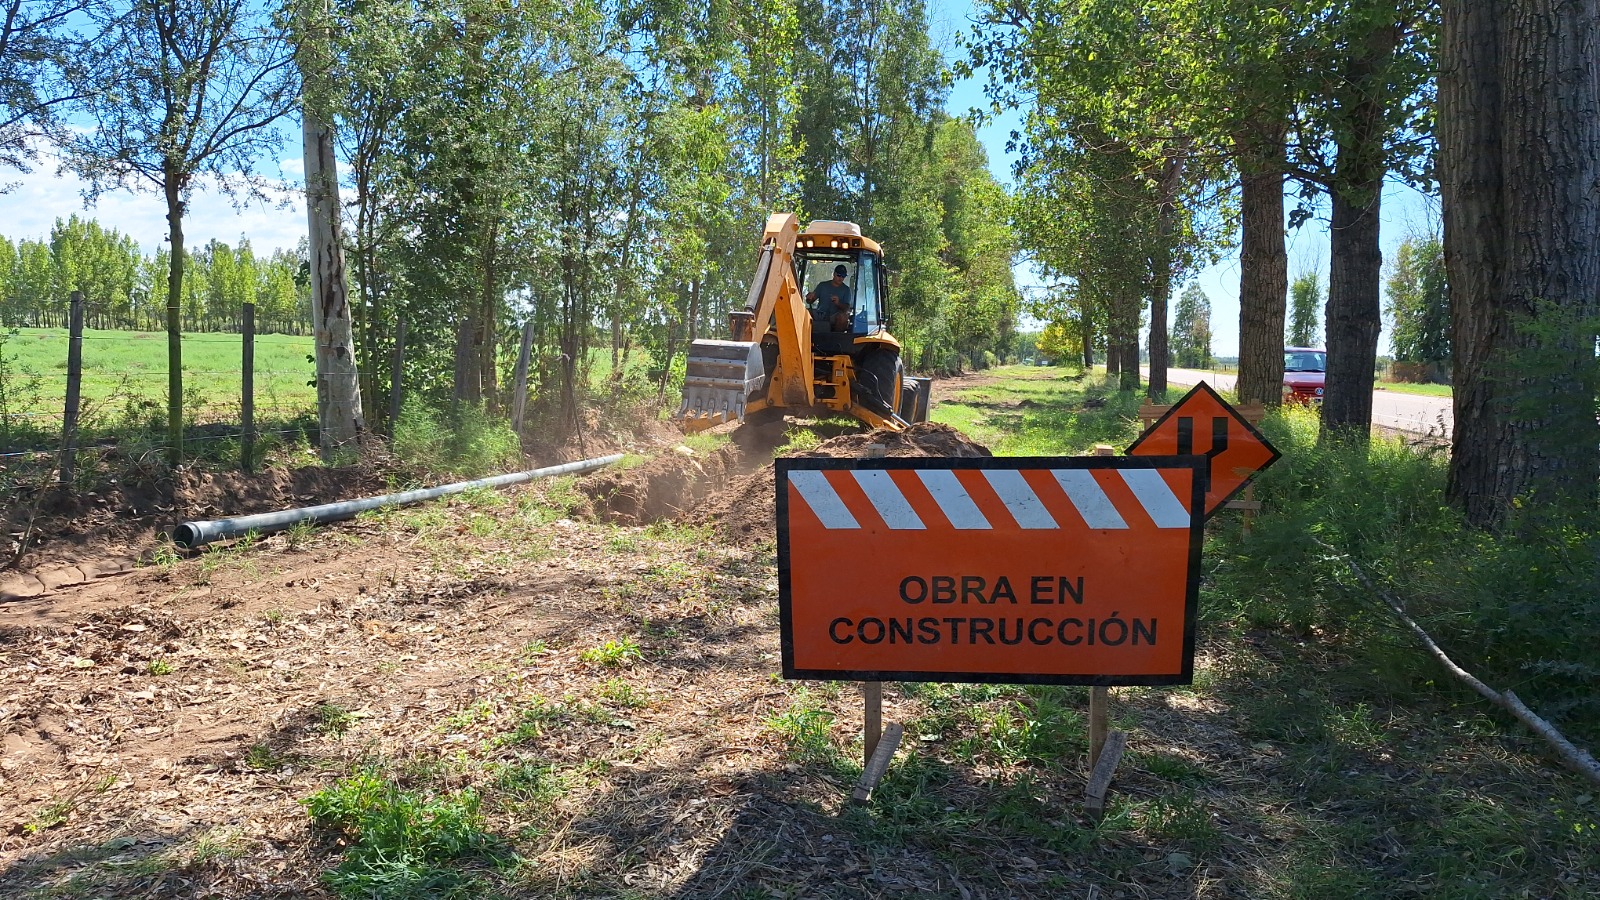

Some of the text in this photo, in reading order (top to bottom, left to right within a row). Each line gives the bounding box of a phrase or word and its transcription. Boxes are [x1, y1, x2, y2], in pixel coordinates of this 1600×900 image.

[899, 576, 1085, 604] OBRA EN
[828, 611, 1158, 646] CONSTRUCCIÓN
